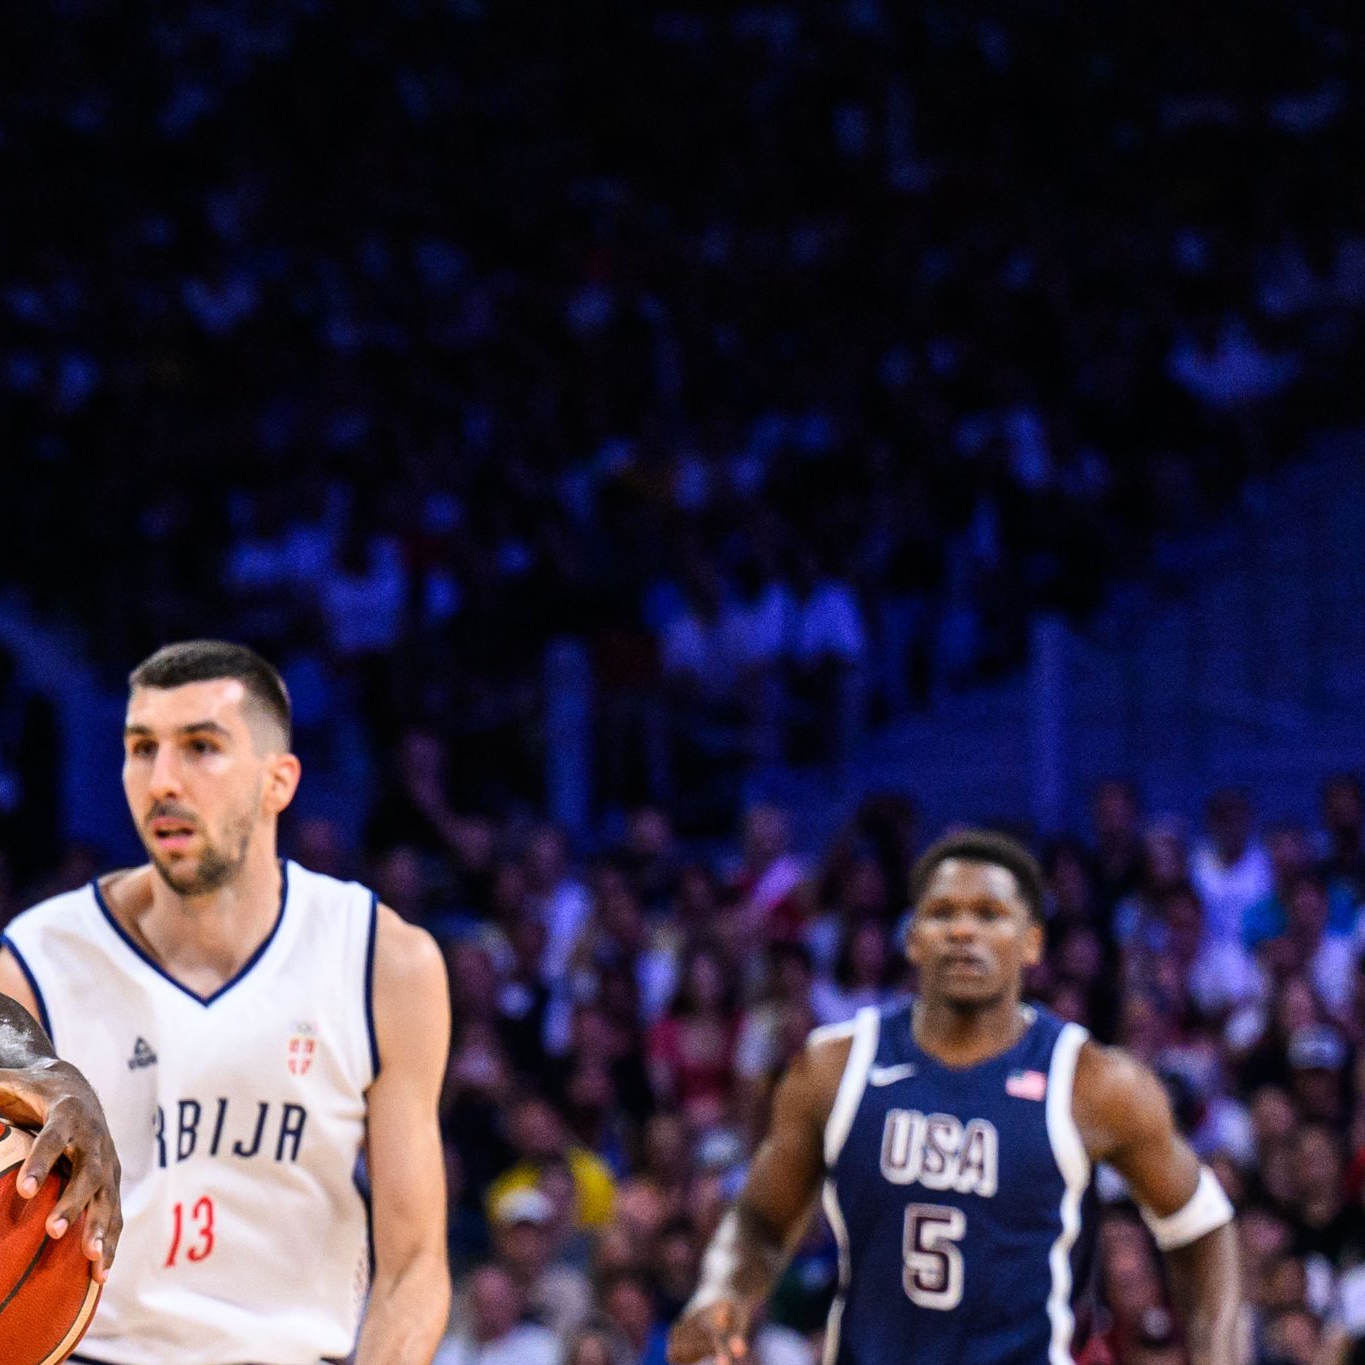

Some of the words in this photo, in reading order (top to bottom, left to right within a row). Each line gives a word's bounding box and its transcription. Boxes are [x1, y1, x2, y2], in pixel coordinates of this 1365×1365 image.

[880, 1108, 999, 1197] USA
[163, 1194, 217, 1268] 13
[902, 1203, 967, 1311] 5
